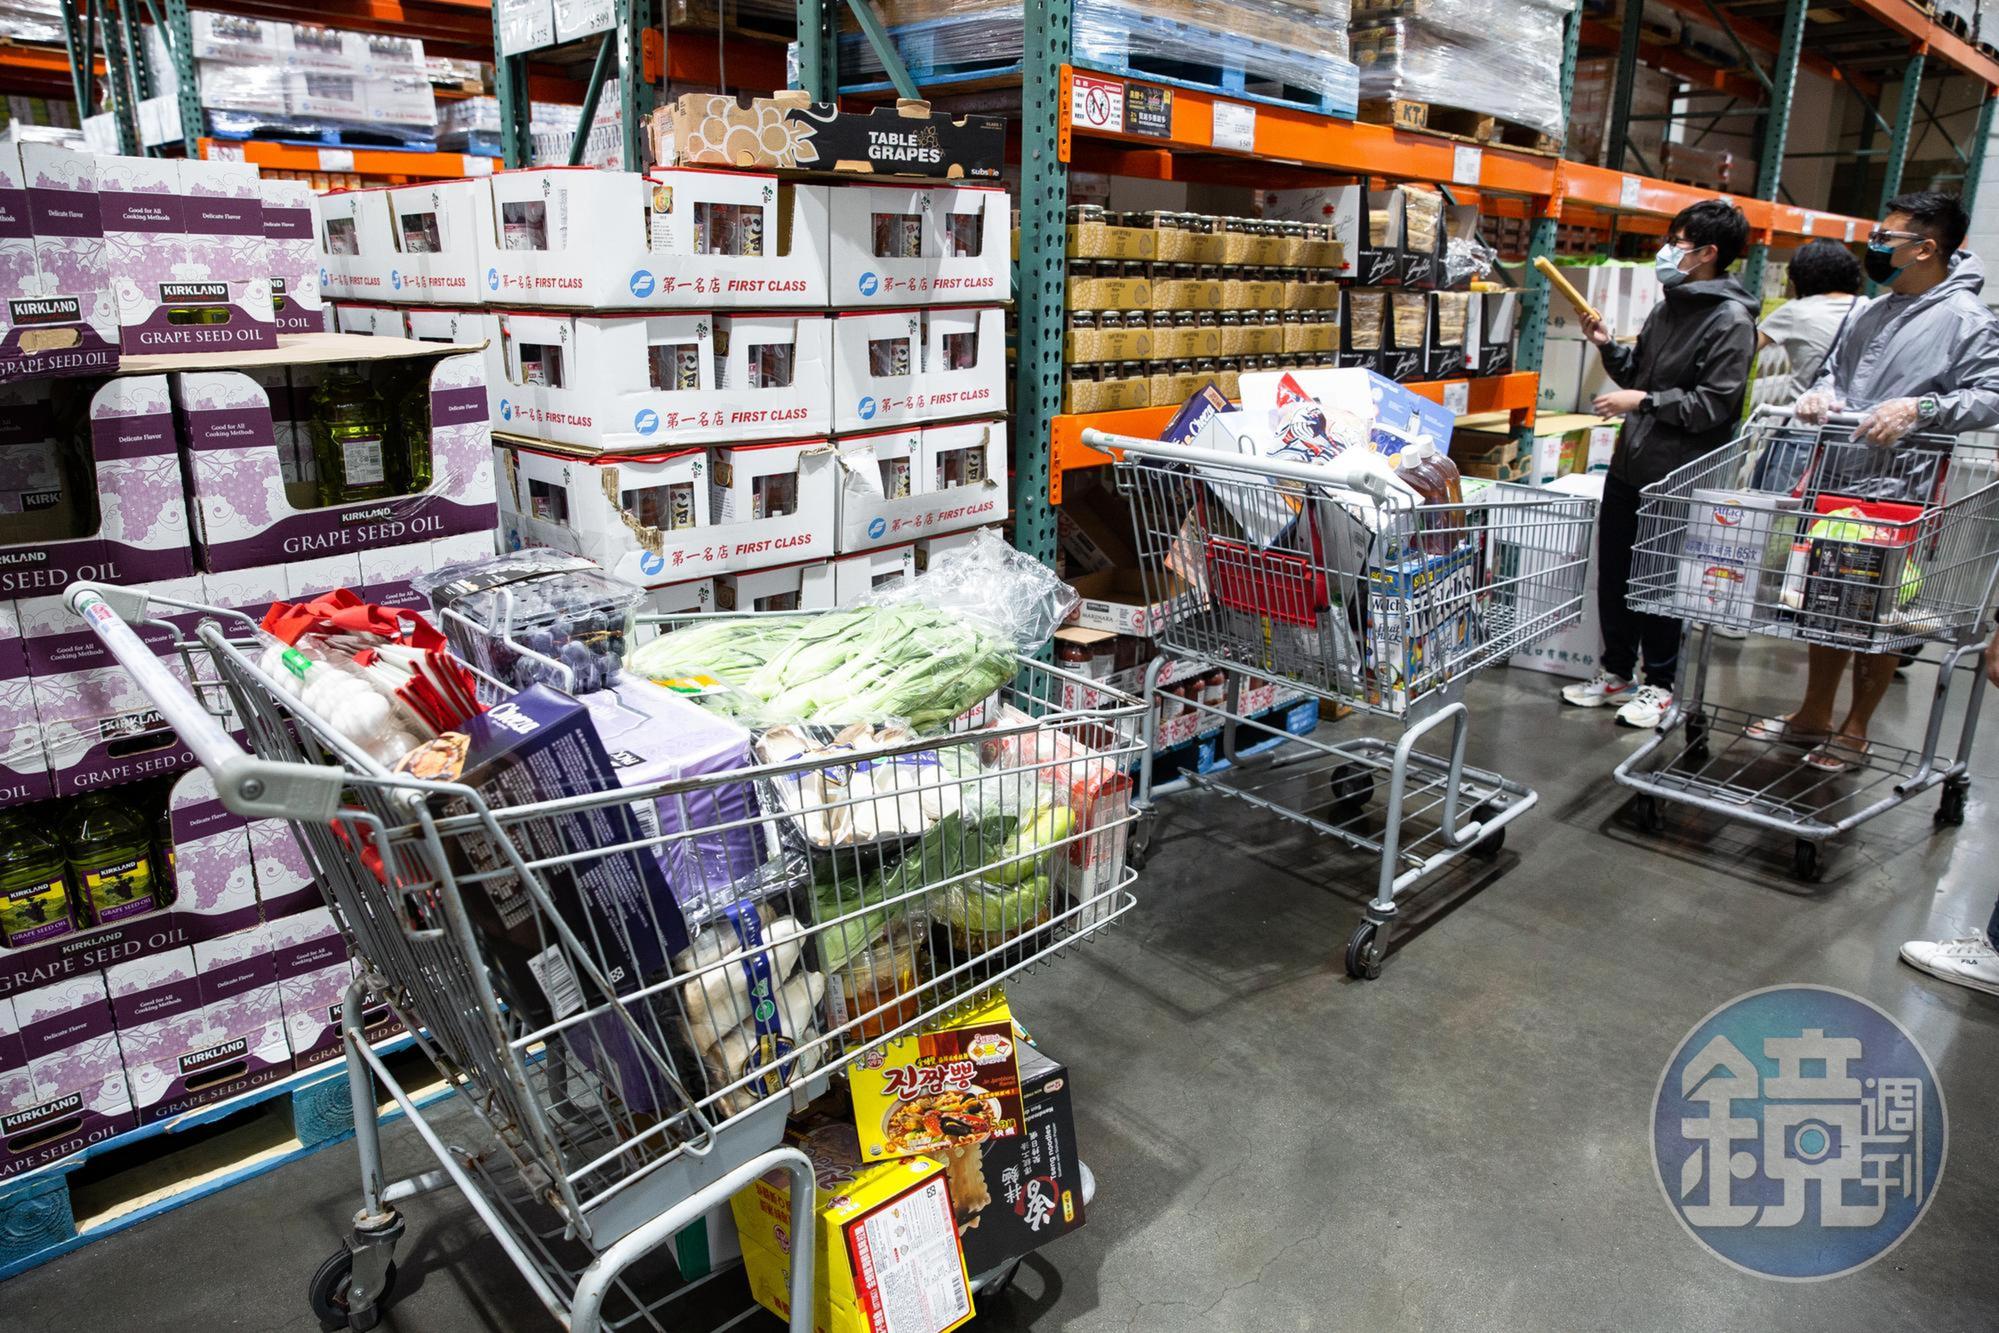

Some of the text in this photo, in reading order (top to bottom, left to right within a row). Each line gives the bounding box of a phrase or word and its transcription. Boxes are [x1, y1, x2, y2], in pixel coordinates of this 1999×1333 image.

[868, 131, 918, 147] TABLE
[868, 145, 941, 164] GRAPES
[122, 213, 170, 222] Cooking Methods
[128, 206, 140, 215] Good
[153, 207, 162, 215] All
[202, 212, 241, 221] Delicate Flavor
[163, 284, 227, 297] KIRKLAND
[535, 277, 556, 289] FIRST
[557, 278, 583, 290] CLASS
[661, 276, 807, 295] 第一名店 FIRST CLASS
[883, 276, 995, 291] 第一名店 FIRST CLASS
[13, 299, 78, 316] KIRKLAND
[289, 317, 311, 330] OIL
[140, 328, 264, 345] GRAPE SEED OIL
[48, 354, 83, 370] SEED
[86, 350, 109, 367] OIL
[465, 403, 479, 411] Flavor
[881, 388, 990, 413] 第一名店 FIRST CLASS
[514, 405, 593, 428] 第一名店 FIRST CLASS
[666, 407, 808, 430] 第一名店 FIRST CLASS
[205, 429, 255, 442] Cooking Methods
[211, 422, 246, 433] Good for All
[118, 432, 163, 444] Delicate Flavor
[342, 506, 392, 523] KIRKLAND
[936, 506, 965, 522] FIRST
[966, 500, 995, 516] CLASS
[283, 514, 446, 555] GRAPE SEED OIL
[671, 533, 812, 566] 第一名店 FIRST CLASS
[2, 561, 122, 592] SEED OIL
[56, 643, 94, 654] Good for All
[144, 634, 167, 644] Delicate
[50, 649, 104, 662] Cooking Methods
[74, 756, 176, 787] GRAPE SEED
[189, 812, 228, 827] Delicate Flavor
[100, 861, 136, 876] KIRKLAND
[10, 883, 49, 899] KIRKLAND
[101, 897, 152, 918] GRAPE SEED OIL
[11, 920, 67, 942] GRAPE SEED OIL
[62, 931, 123, 955] KIRKLAND
[83, 941, 142, 969] SEED
[149, 928, 190, 951] OIL
[217, 972, 255, 990] Delicate Flavor
[134, 997, 182, 1016] Cooking Methods
[139, 999, 154, 1009] Good
[163, 993, 173, 1003] All
[43, 1021, 88, 1042] Delicate Flavor
[182, 1041, 246, 1066] KIRKLAND
[309, 1044, 345, 1063] GRAP
[881, 1060, 978, 1101] 진짬뽕
[156, 1070, 277, 1118] GRAPE SEED OIL
[5, 1095, 80, 1128] KIRKLAND
[41, 1136, 84, 1164] SEED
[88, 1125, 119, 1145] OIL
[1044, 1124, 1058, 1181] Tseng noodles
